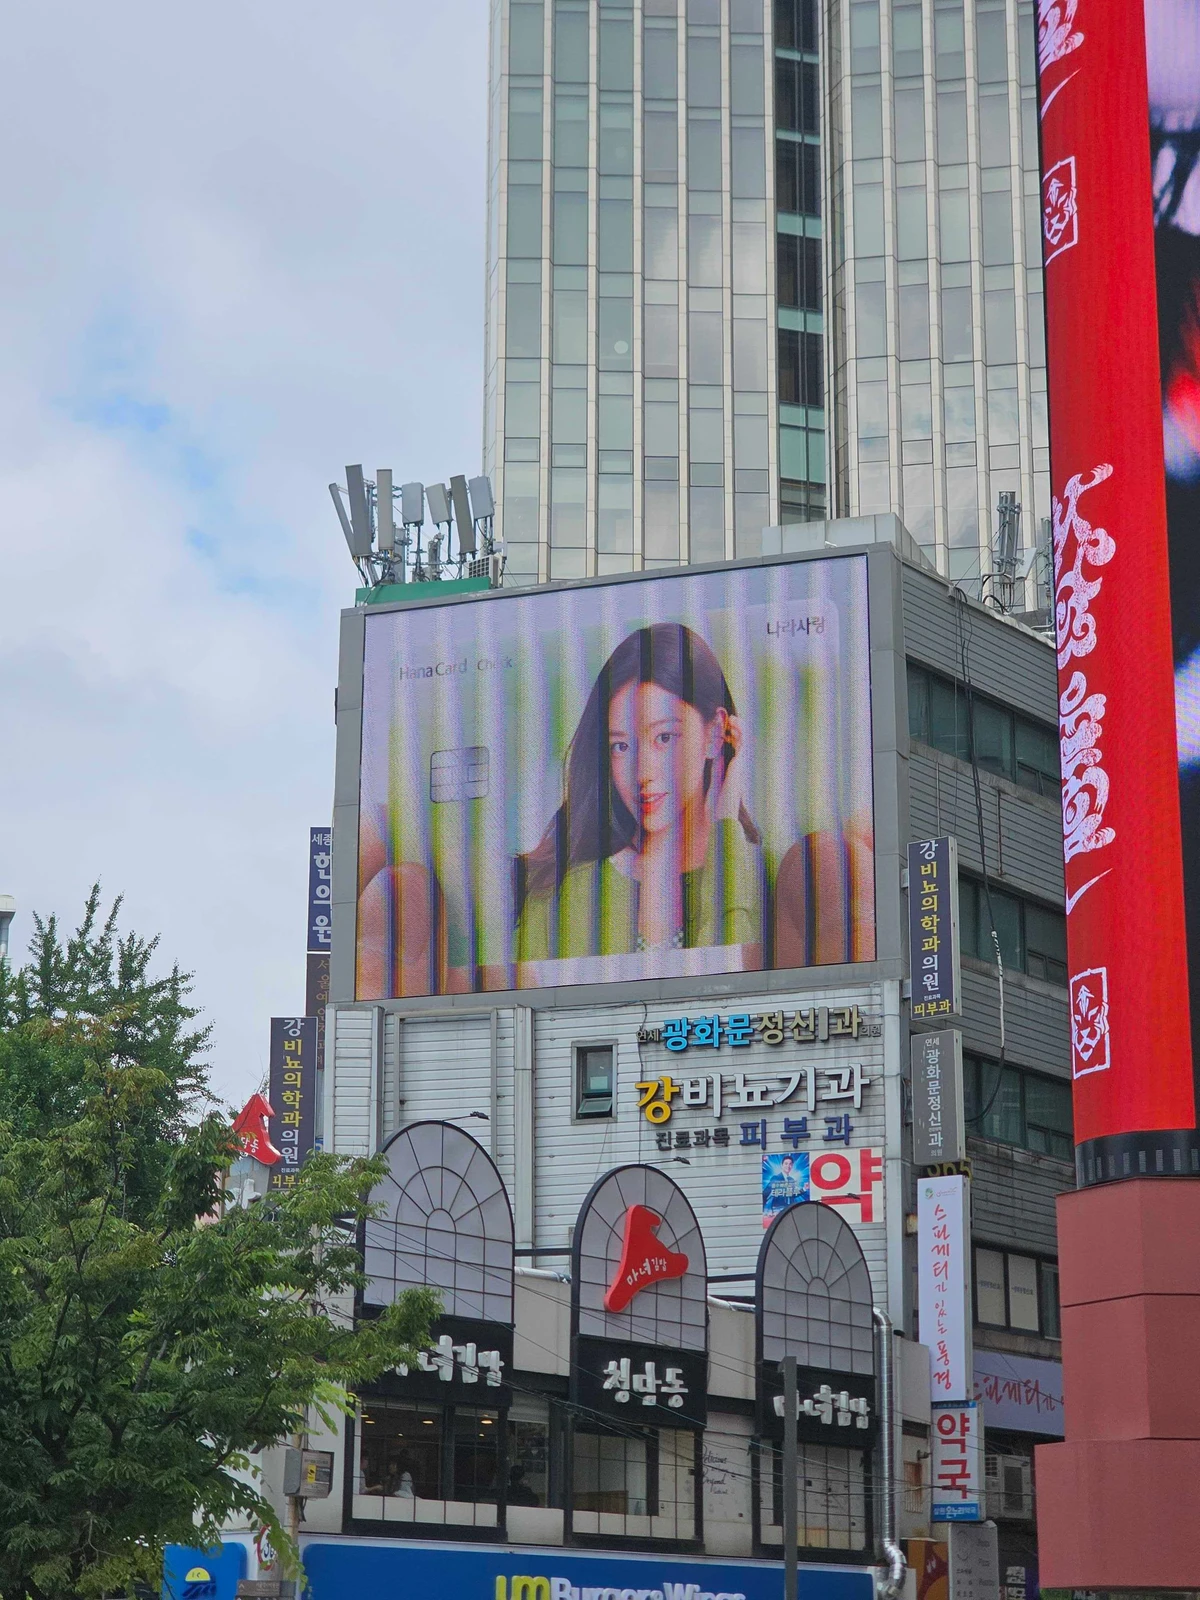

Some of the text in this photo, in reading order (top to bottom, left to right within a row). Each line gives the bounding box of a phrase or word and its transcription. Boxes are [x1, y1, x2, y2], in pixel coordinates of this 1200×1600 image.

[766, 615, 825, 638] 나라사랑
[435, 658, 467, 676] Card
[920, 840, 941, 992] 강비뇨의학과의원
[914, 998, 951, 1017] 피부과
[281, 1018, 305, 1164] 강비뇨의학과의원
[635, 1063, 871, 1124] 강비뇨기과
[655, 1113, 854, 1151] 진료과목 피부과
[810, 1149, 882, 1223] 약
[602, 1357, 689, 1408] 청담동
[936, 1412, 971, 1500] 약국
